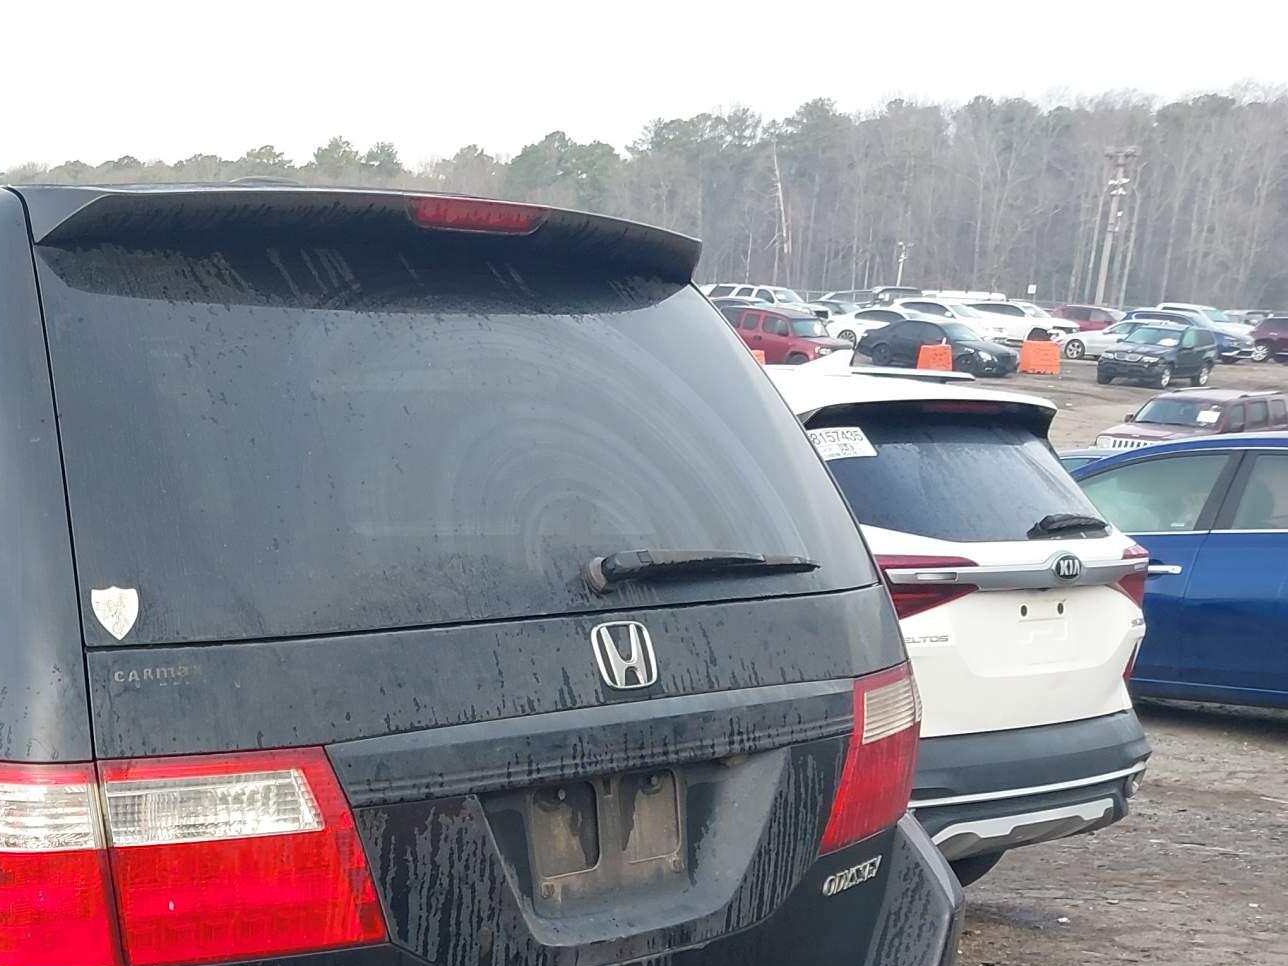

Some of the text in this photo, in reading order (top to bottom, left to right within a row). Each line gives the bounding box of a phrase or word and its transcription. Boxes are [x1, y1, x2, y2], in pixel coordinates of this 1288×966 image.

[808, 430, 863, 445] 8157435
[1059, 559, 1080, 576] KIA
[904, 635, 949, 644] ELTOS
